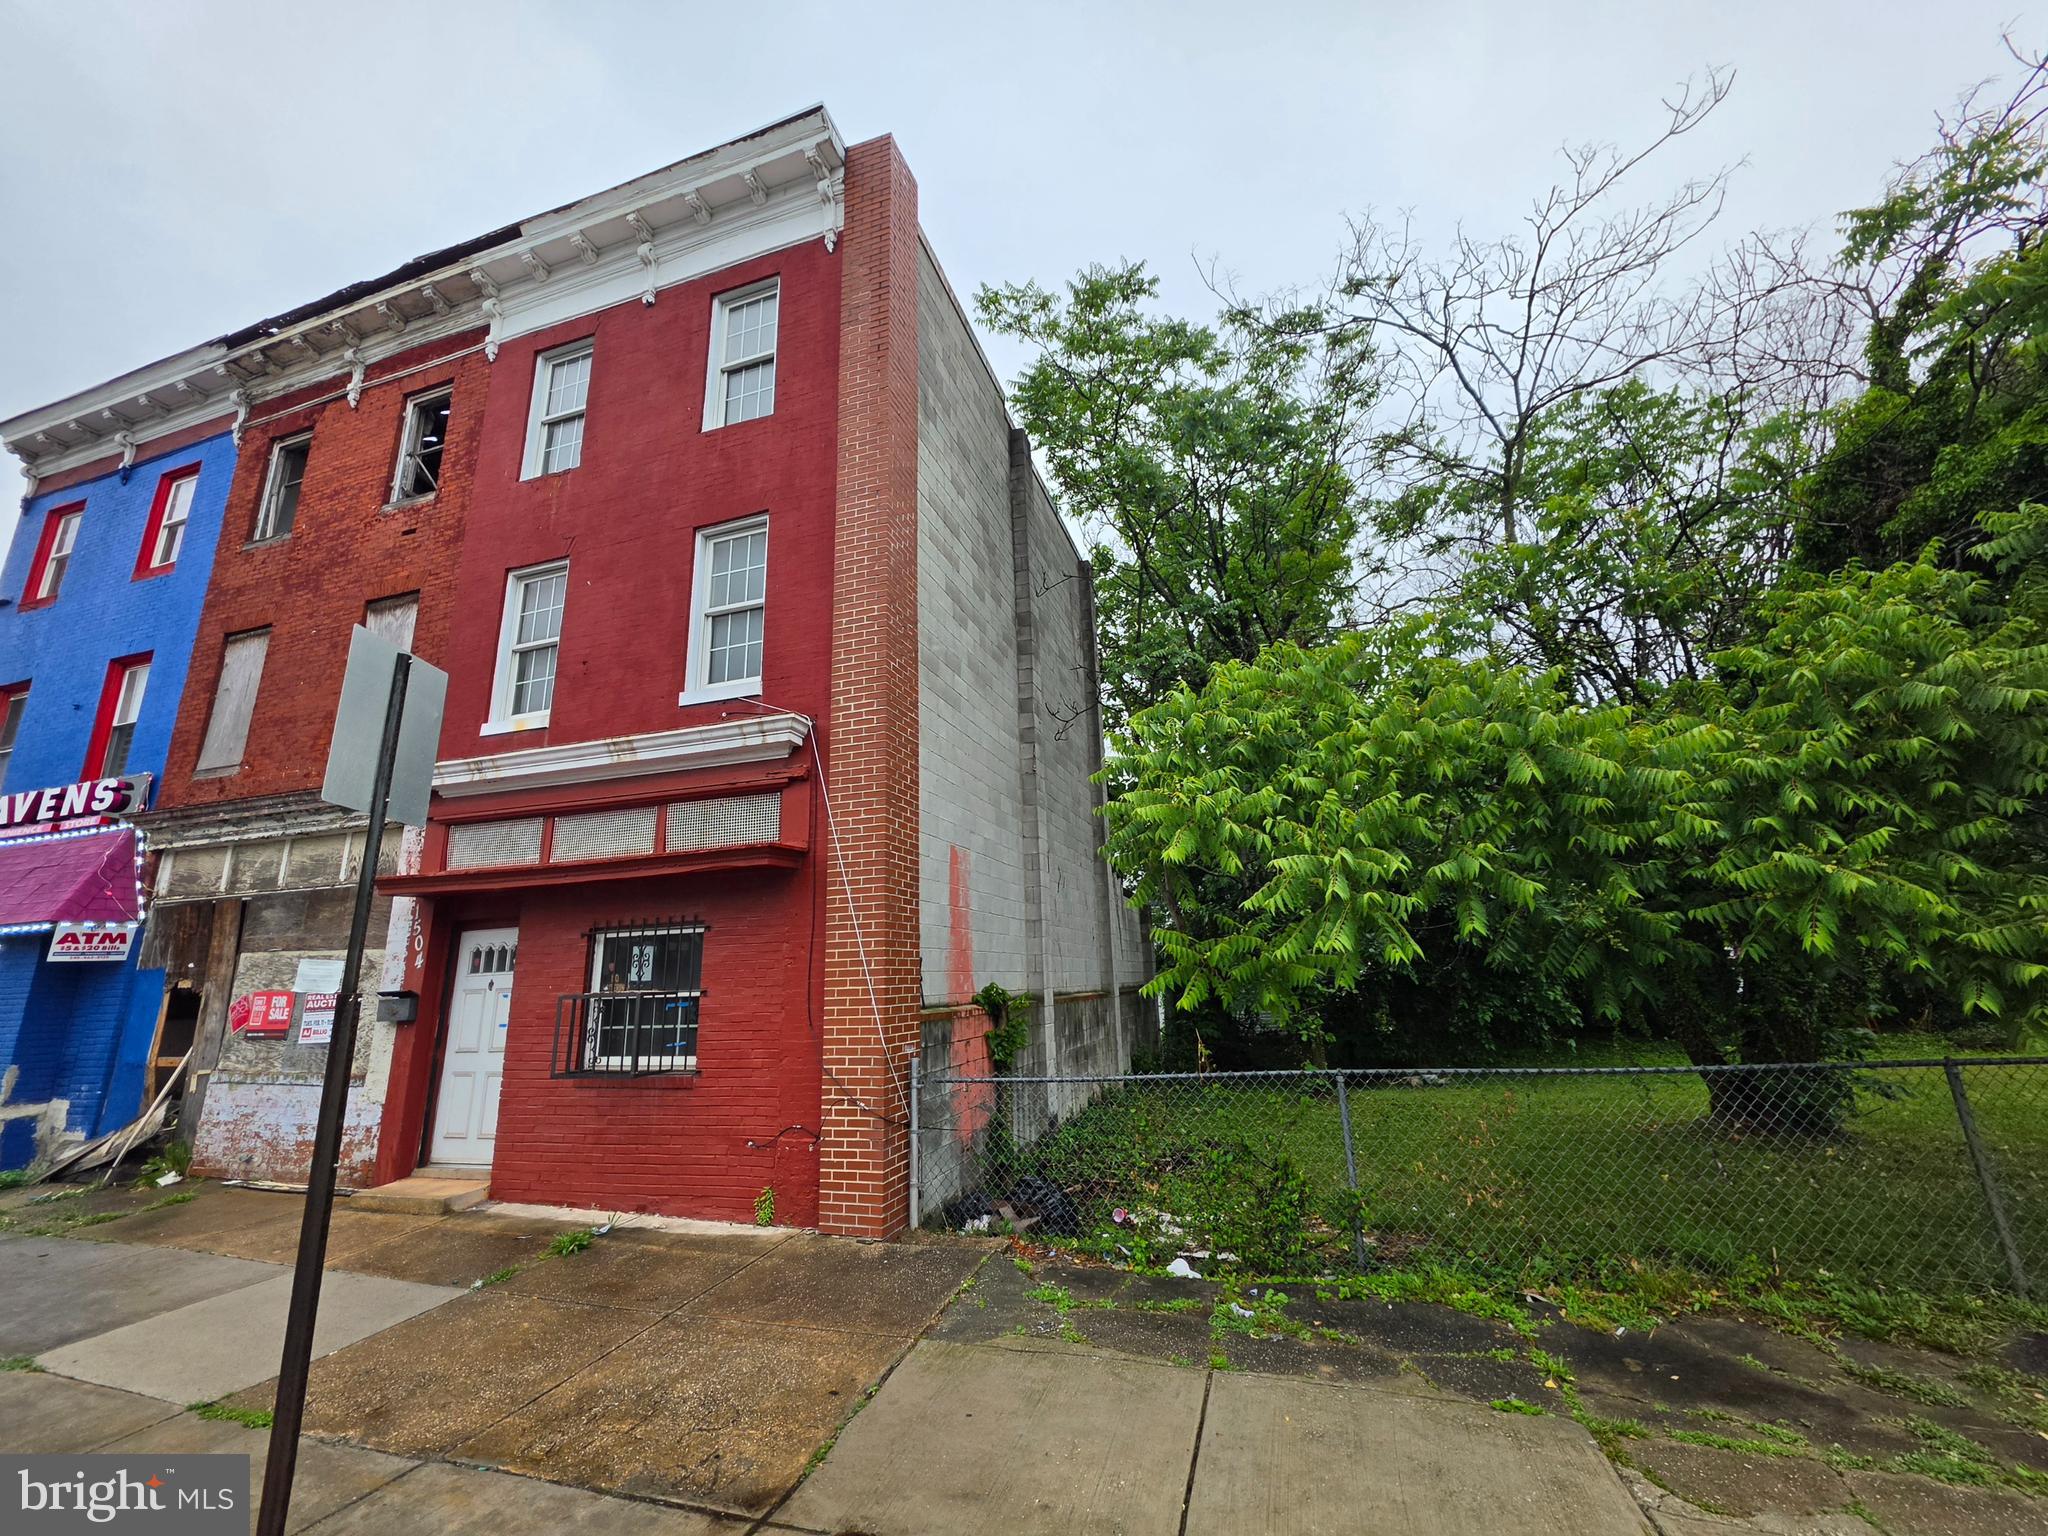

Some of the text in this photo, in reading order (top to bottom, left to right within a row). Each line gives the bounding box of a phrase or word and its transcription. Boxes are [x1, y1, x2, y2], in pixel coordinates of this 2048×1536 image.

[56, 932, 127, 945] ATM
[412, 903, 424, 969] 1504
[271, 996, 287, 1008] FOR
[268, 1008, 289, 1020] SALE
